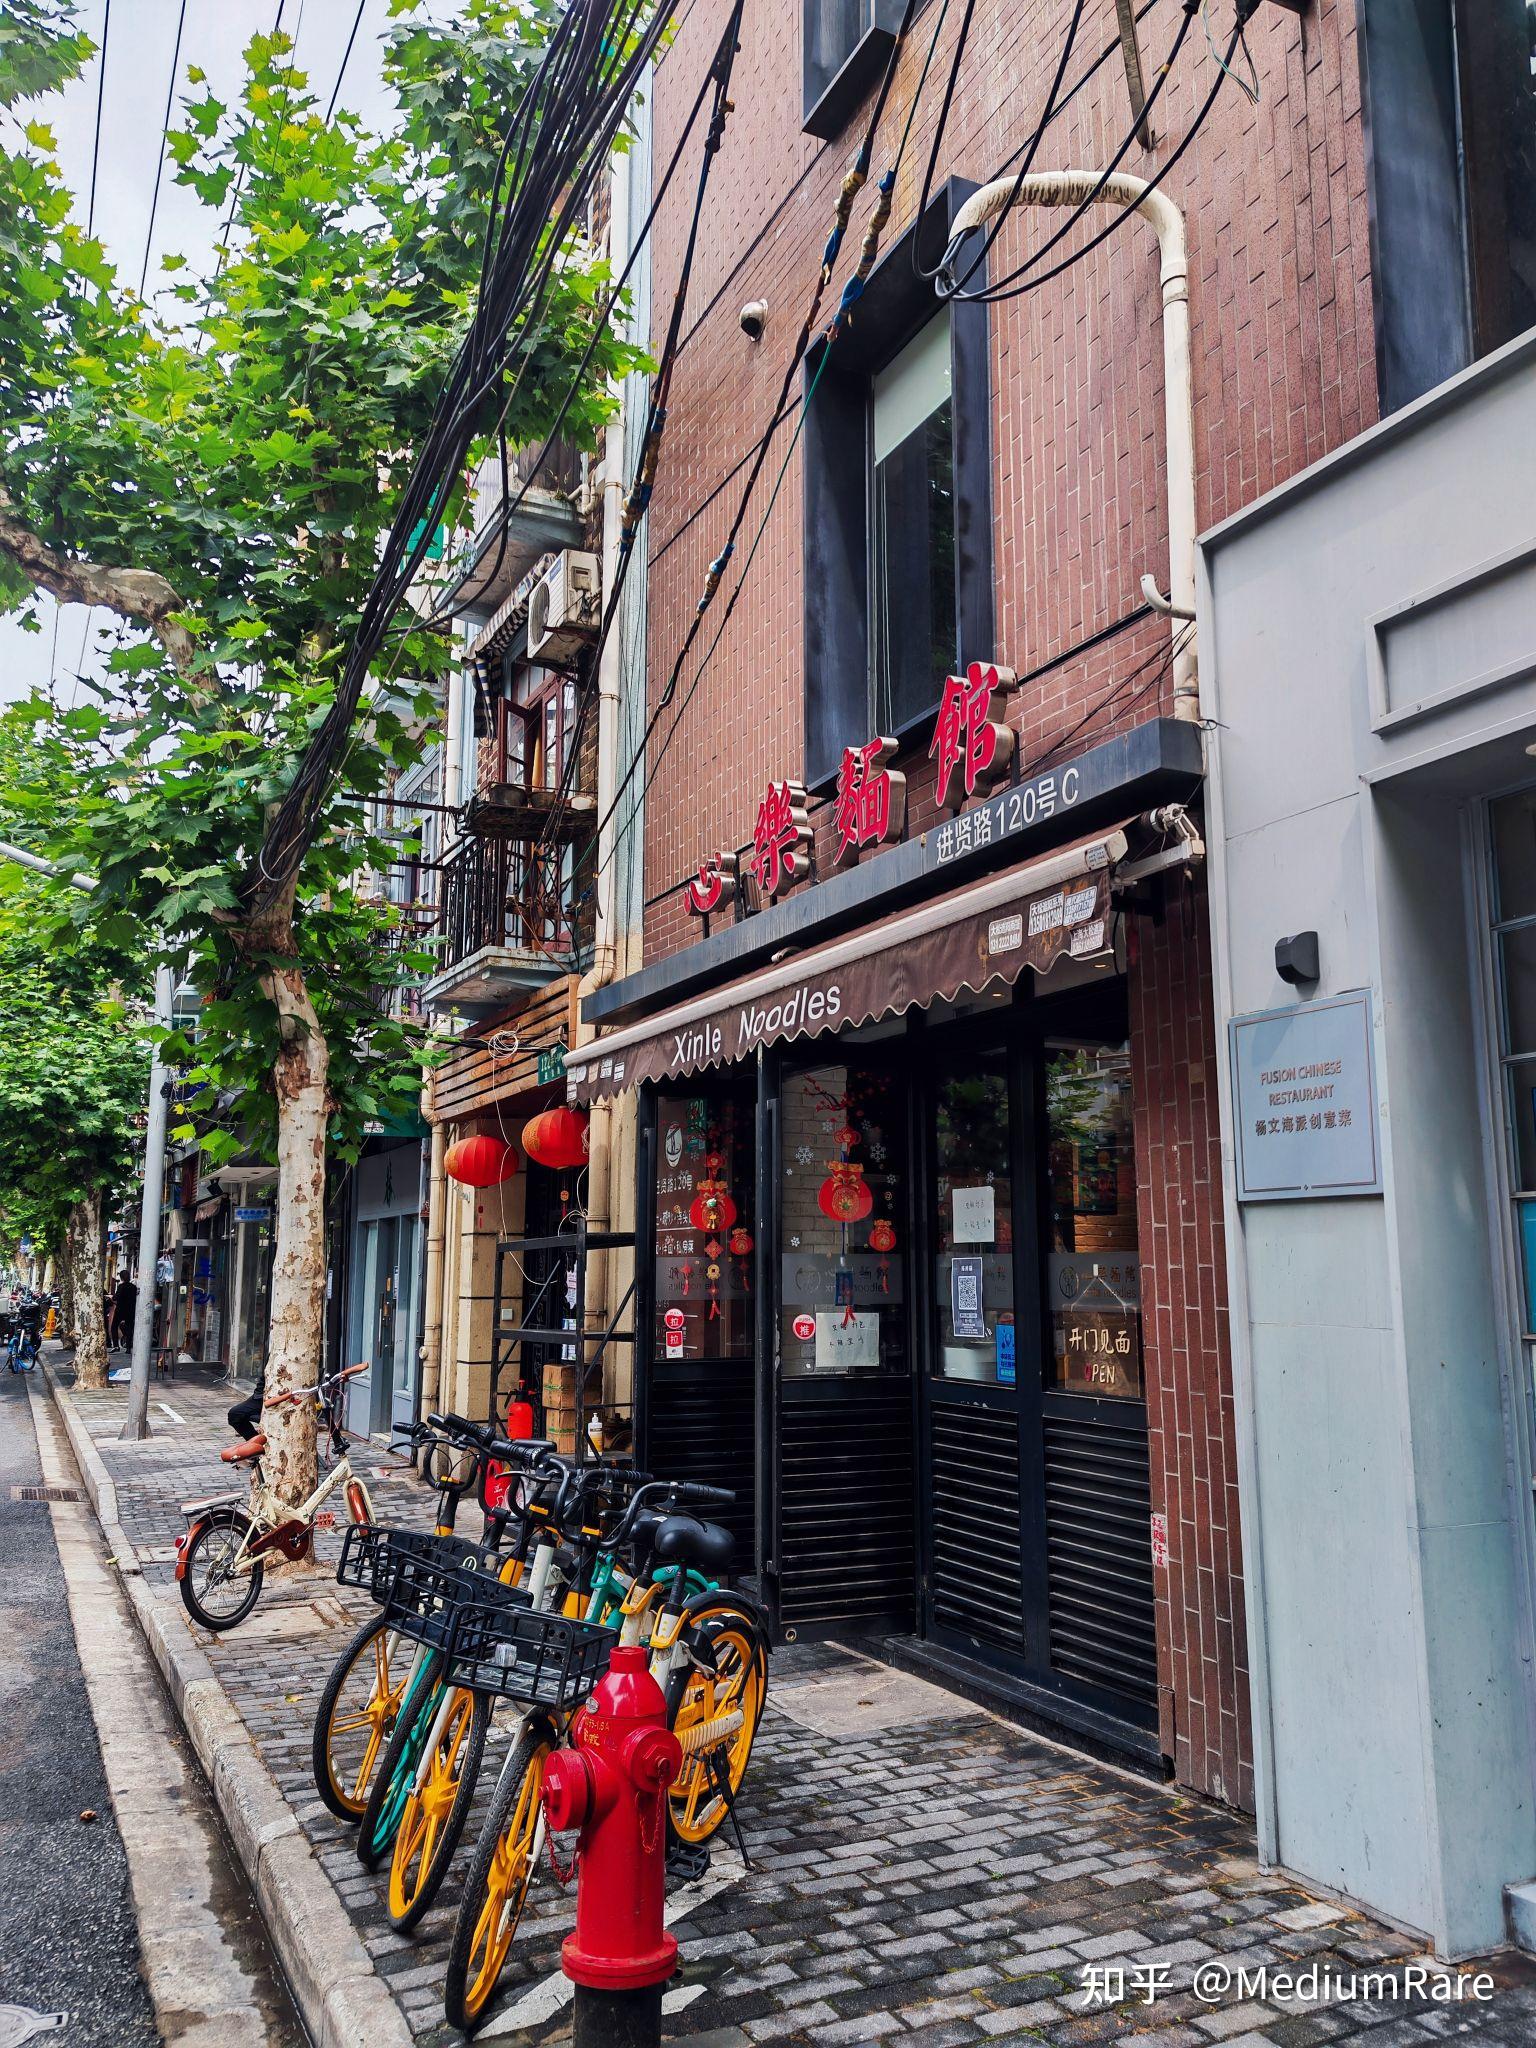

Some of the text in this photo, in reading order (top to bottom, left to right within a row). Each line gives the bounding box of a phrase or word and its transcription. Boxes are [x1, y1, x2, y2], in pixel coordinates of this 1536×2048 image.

[671, 985, 841, 1067] Xinle Noodles
[1261, 1059, 1342, 1086] FUSION CHINESE
[1269, 1084, 1334, 1106] RESTAURANT
[671, 1317, 679, 1327] 拉
[800, 1325, 810, 1336] 推
[670, 1335, 679, 1344] 拉
[1069, 1327, 1131, 1354] 开门见面
[1085, 1362, 1116, 1384] OPEN
